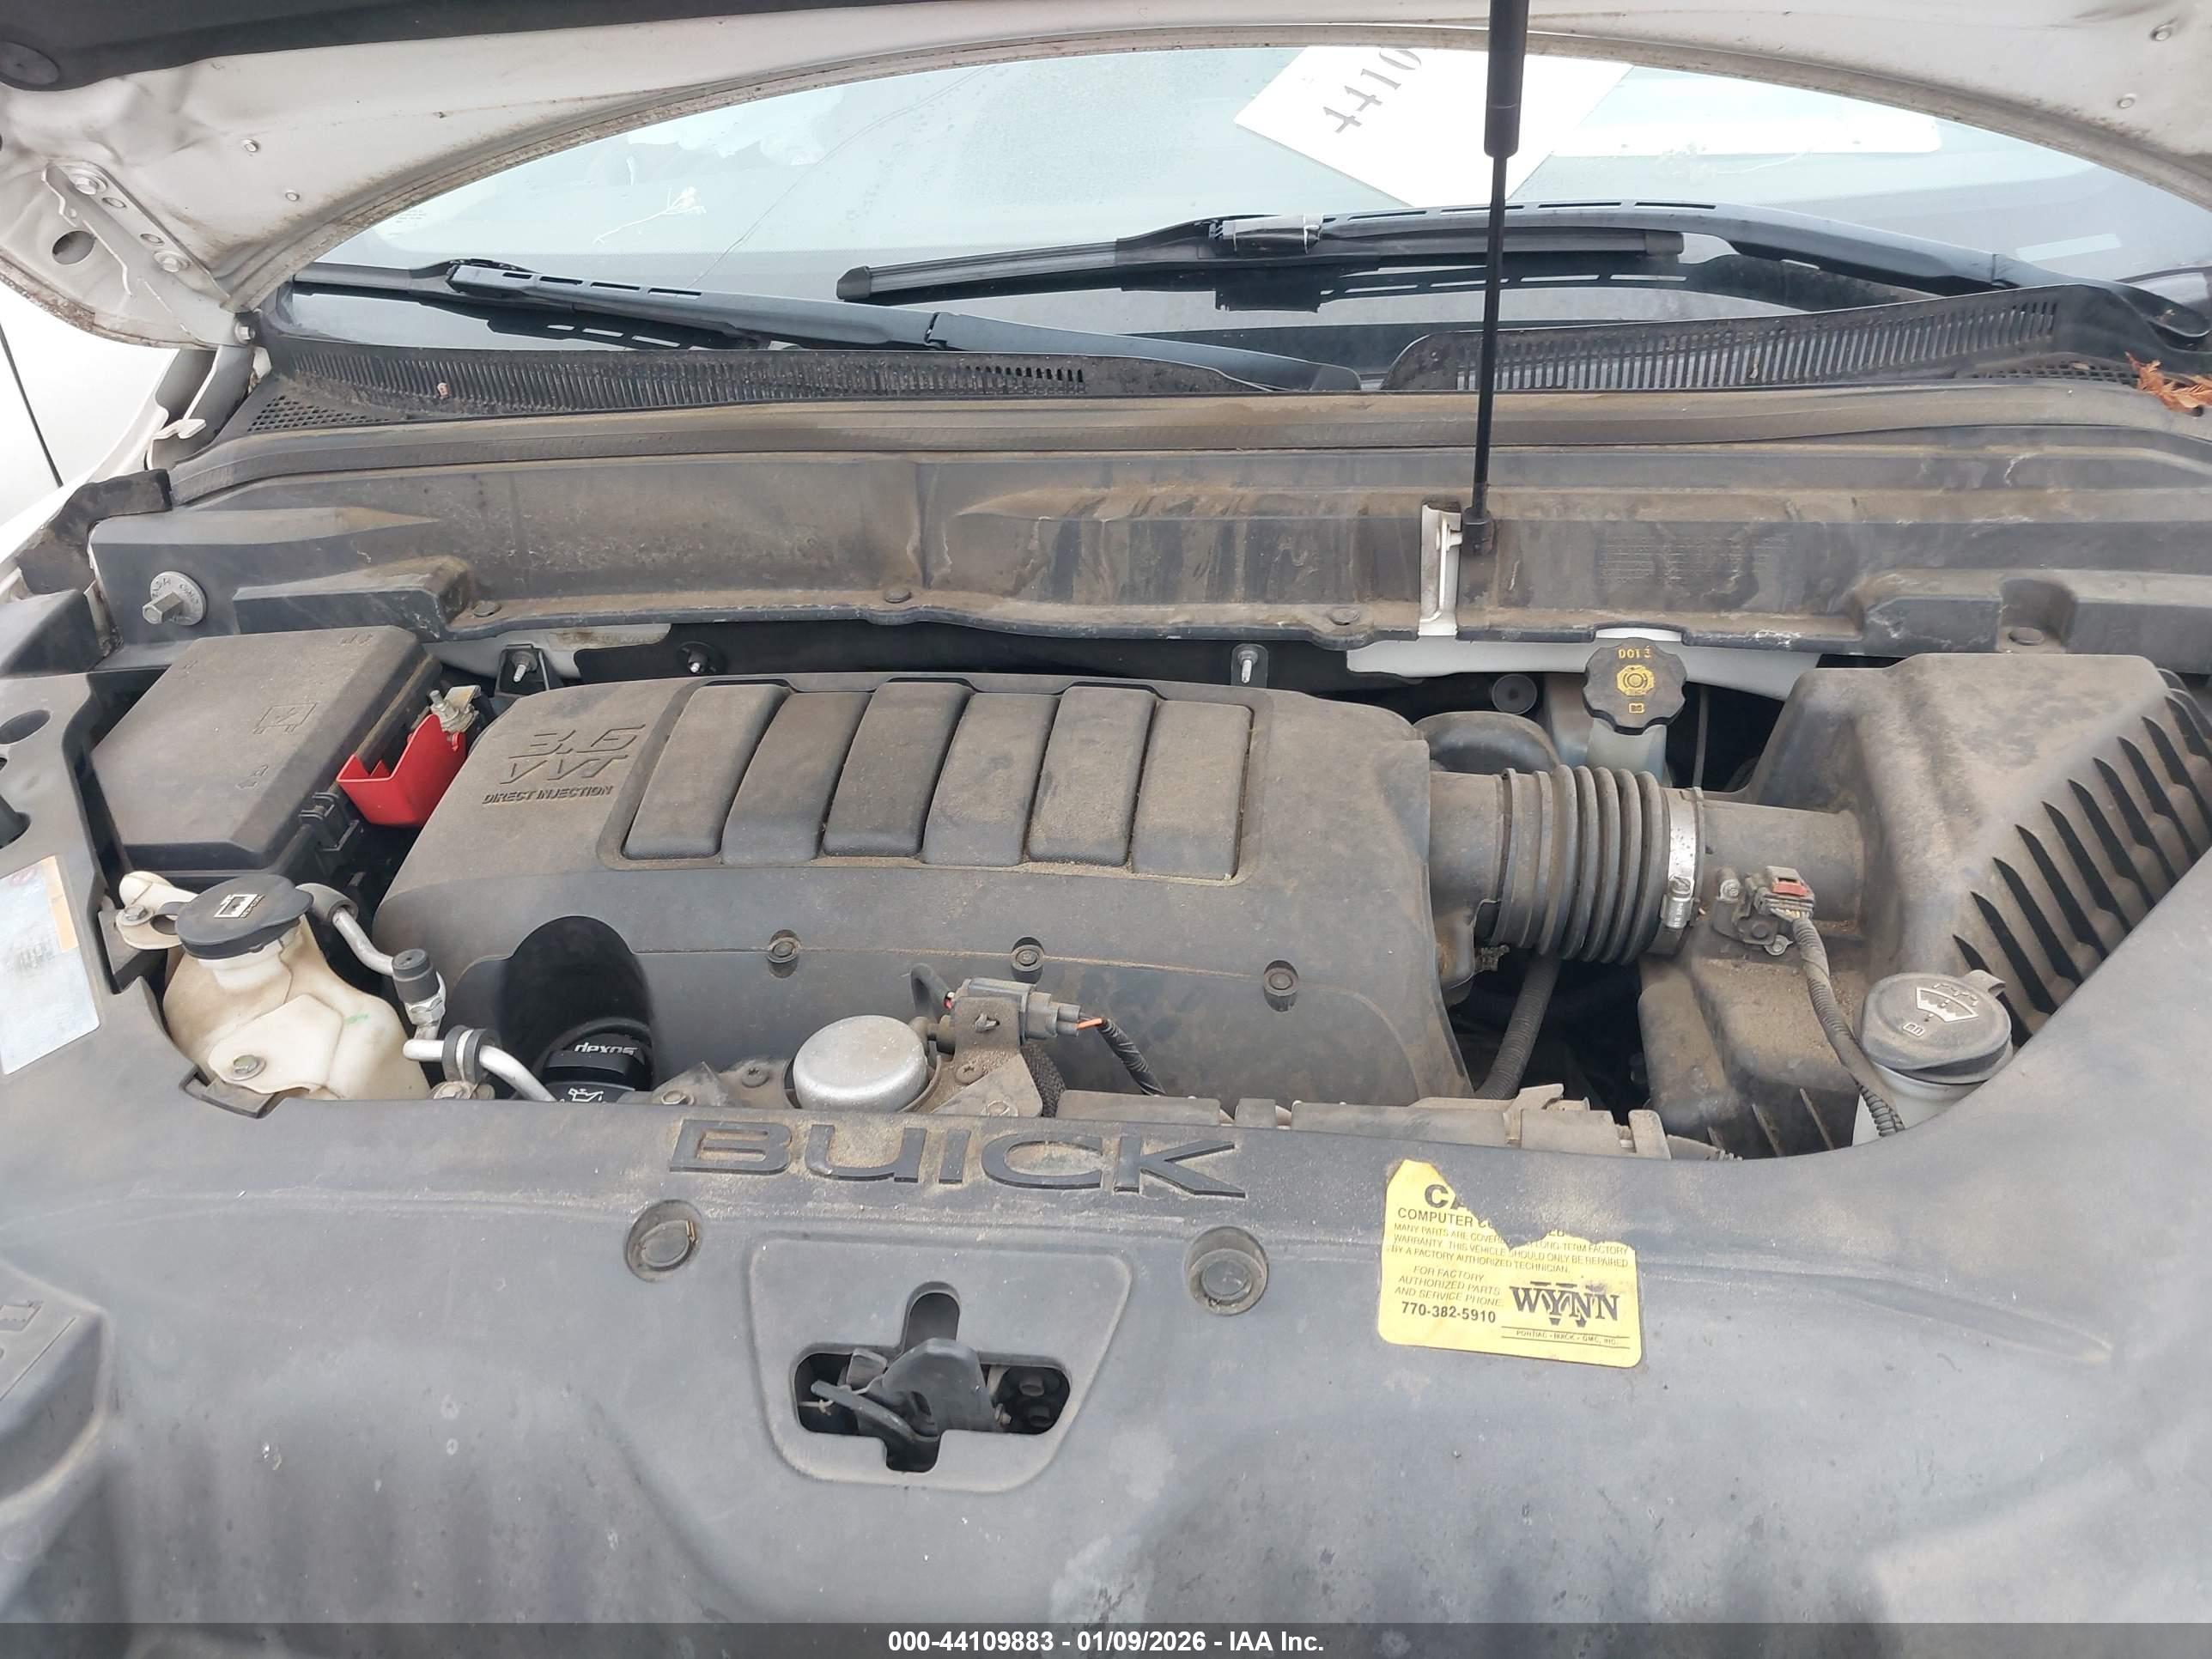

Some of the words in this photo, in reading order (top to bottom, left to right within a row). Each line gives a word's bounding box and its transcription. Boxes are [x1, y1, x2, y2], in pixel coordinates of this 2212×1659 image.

[1618, 648, 1641, 659] DOT
[508, 724, 646, 759] 3.6
[500, 755, 629, 784] VVT
[482, 790, 537, 805] DIRECT
[537, 785, 614, 800] INJECTION
[670, 1118, 1246, 1199] BUICK
[1398, 1207, 1473, 1227] COMPUTER
[1395, 1223, 1419, 1231] MANY
[1422, 1226, 1449, 1237] PARTS
[1451, 1231, 1468, 1240] ARE
[1589, 1244, 1628, 1255] FACTORY
[1391, 1245, 1402, 1254] BY
[1414, 1248, 1455, 1261] FACTORY
[1456, 1255, 1512, 1267] AUTHORIZED
[1449, 1242, 1468, 1251] THIS
[1470, 1243, 1506, 1256] VEHICLE
[1509, 1250, 1545, 1261] SHOULD
[1547, 1254, 1570, 1263] ONLY
[1572, 1255, 1583, 1264] BE
[1586, 1257, 1628, 1267] REPAIRED
[1413, 1266, 1435, 1276] FOR
[1437, 1269, 1485, 1282] FACTORY
[1395, 1286, 1416, 1297] AND
[1419, 1289, 1462, 1301] SERVICE
[1398, 1275, 1465, 1290] AUTHORIZED
[1468, 1285, 1501, 1297] PARTS
[1401, 1301, 1496, 1323] 770-382-5910
[1510, 1284, 1620, 1323] WYNN
[1516, 1330, 1547, 1339] PONTIAC
